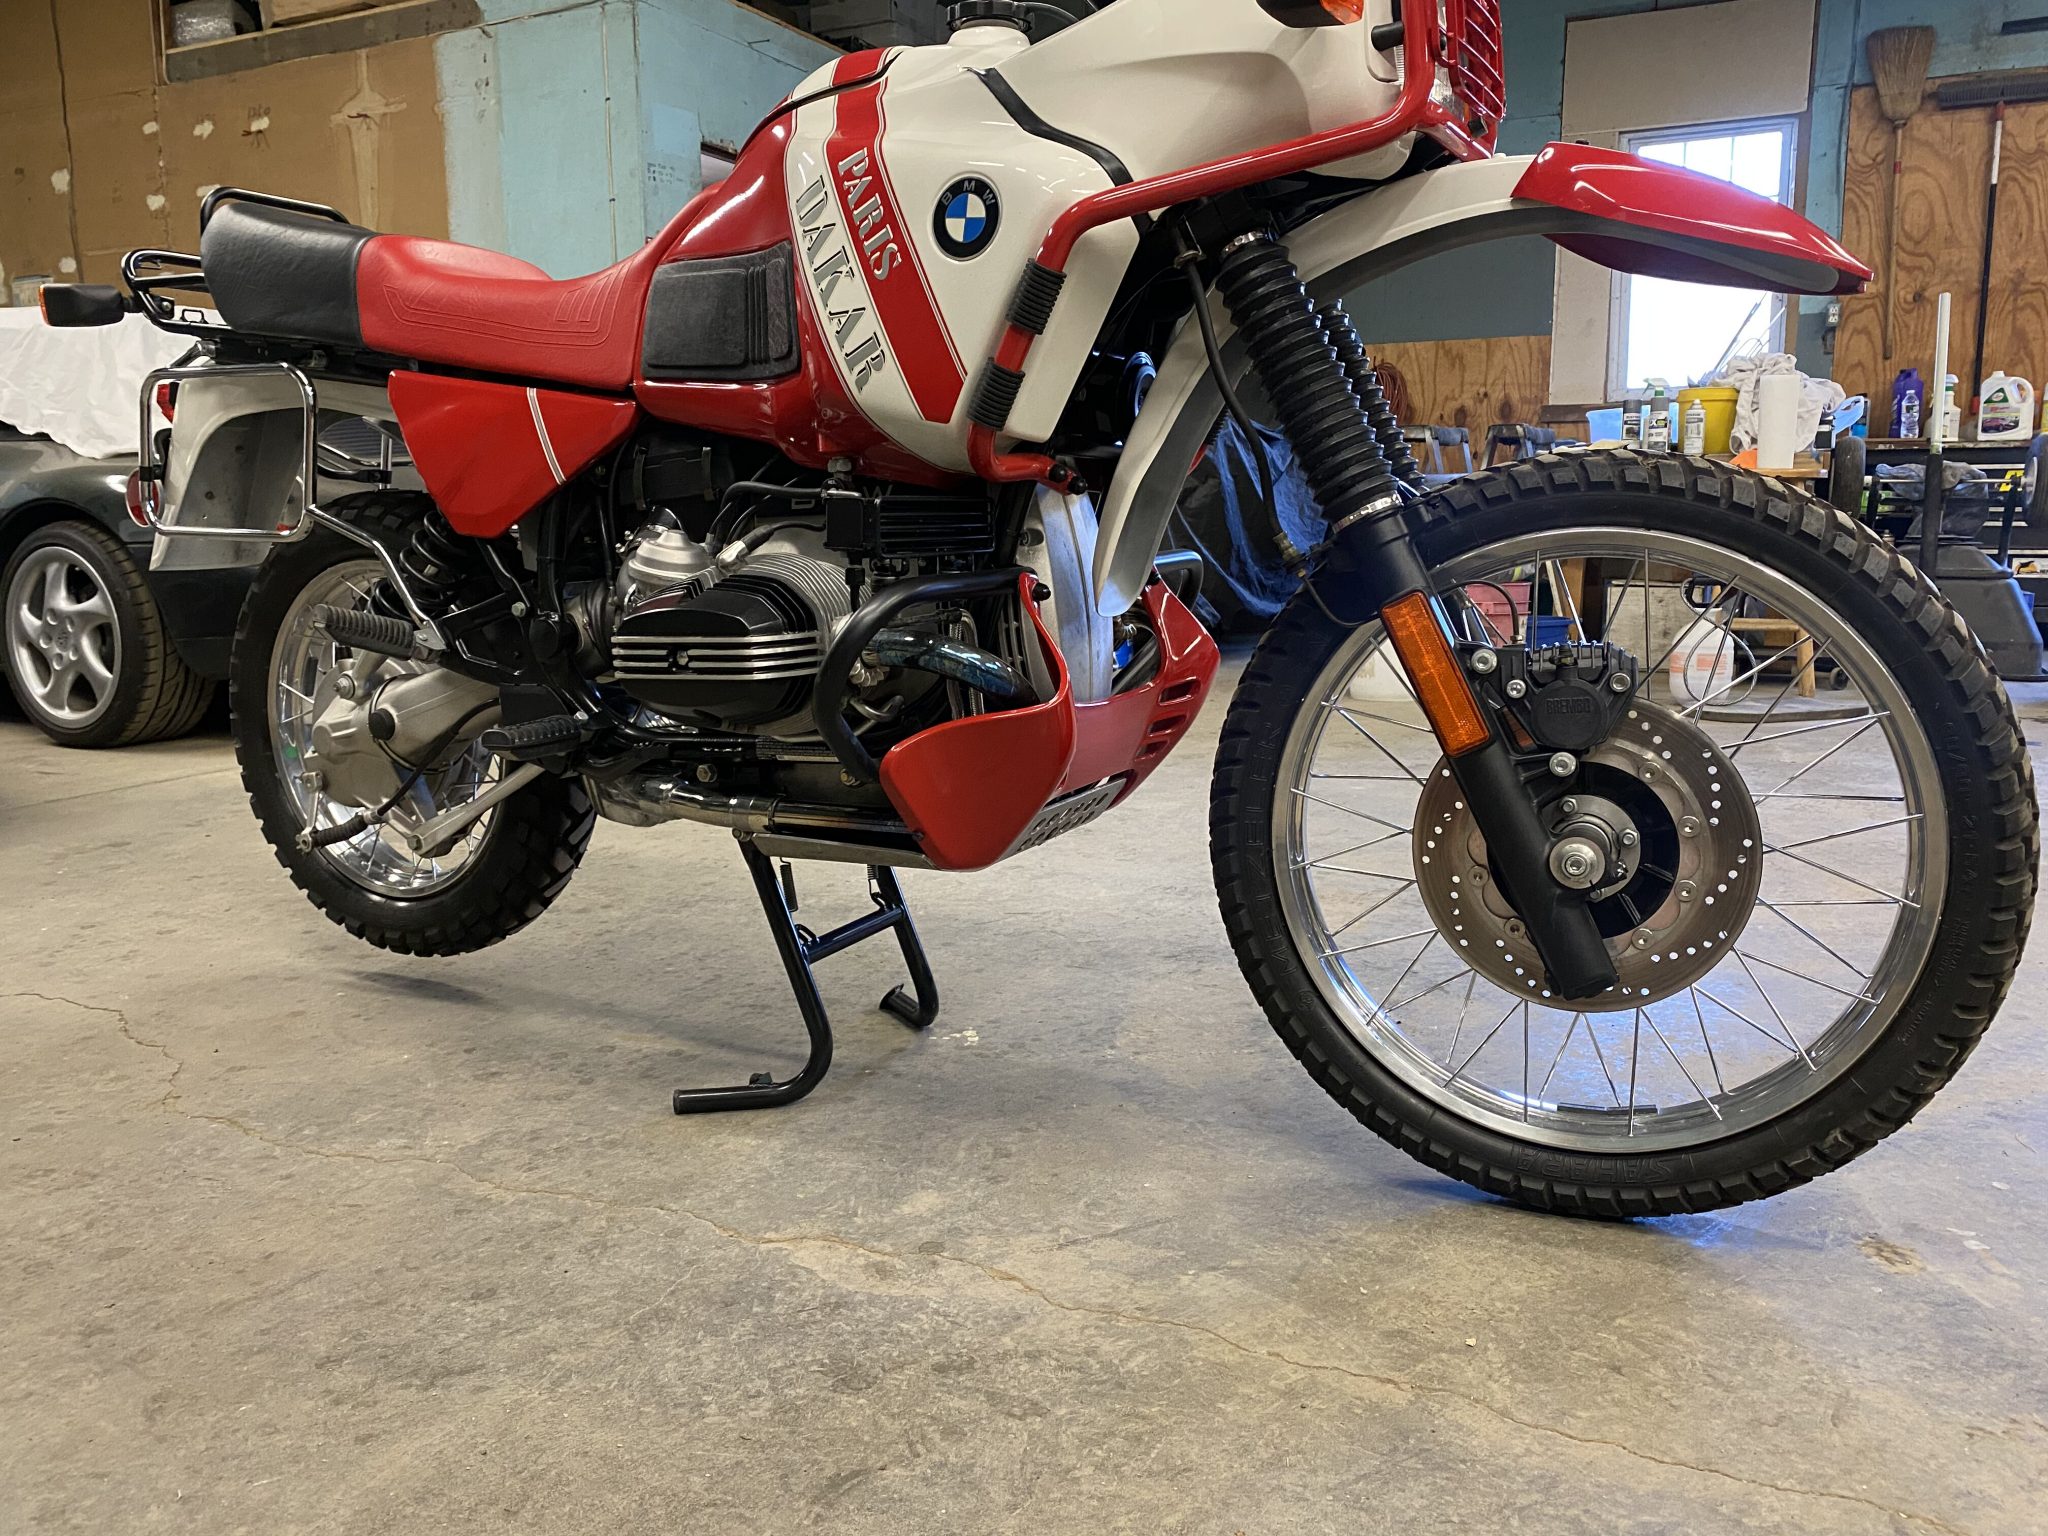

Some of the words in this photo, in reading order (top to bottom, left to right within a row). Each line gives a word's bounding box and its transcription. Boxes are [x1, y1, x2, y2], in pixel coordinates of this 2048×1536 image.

[941, 180, 996, 206] BMW
[837, 147, 902, 281] PARIS
[795, 174, 887, 394] DAKAR
[1545, 697, 1592, 714] BREMBO
[1517, 1147, 1682, 1184] SAHARA
